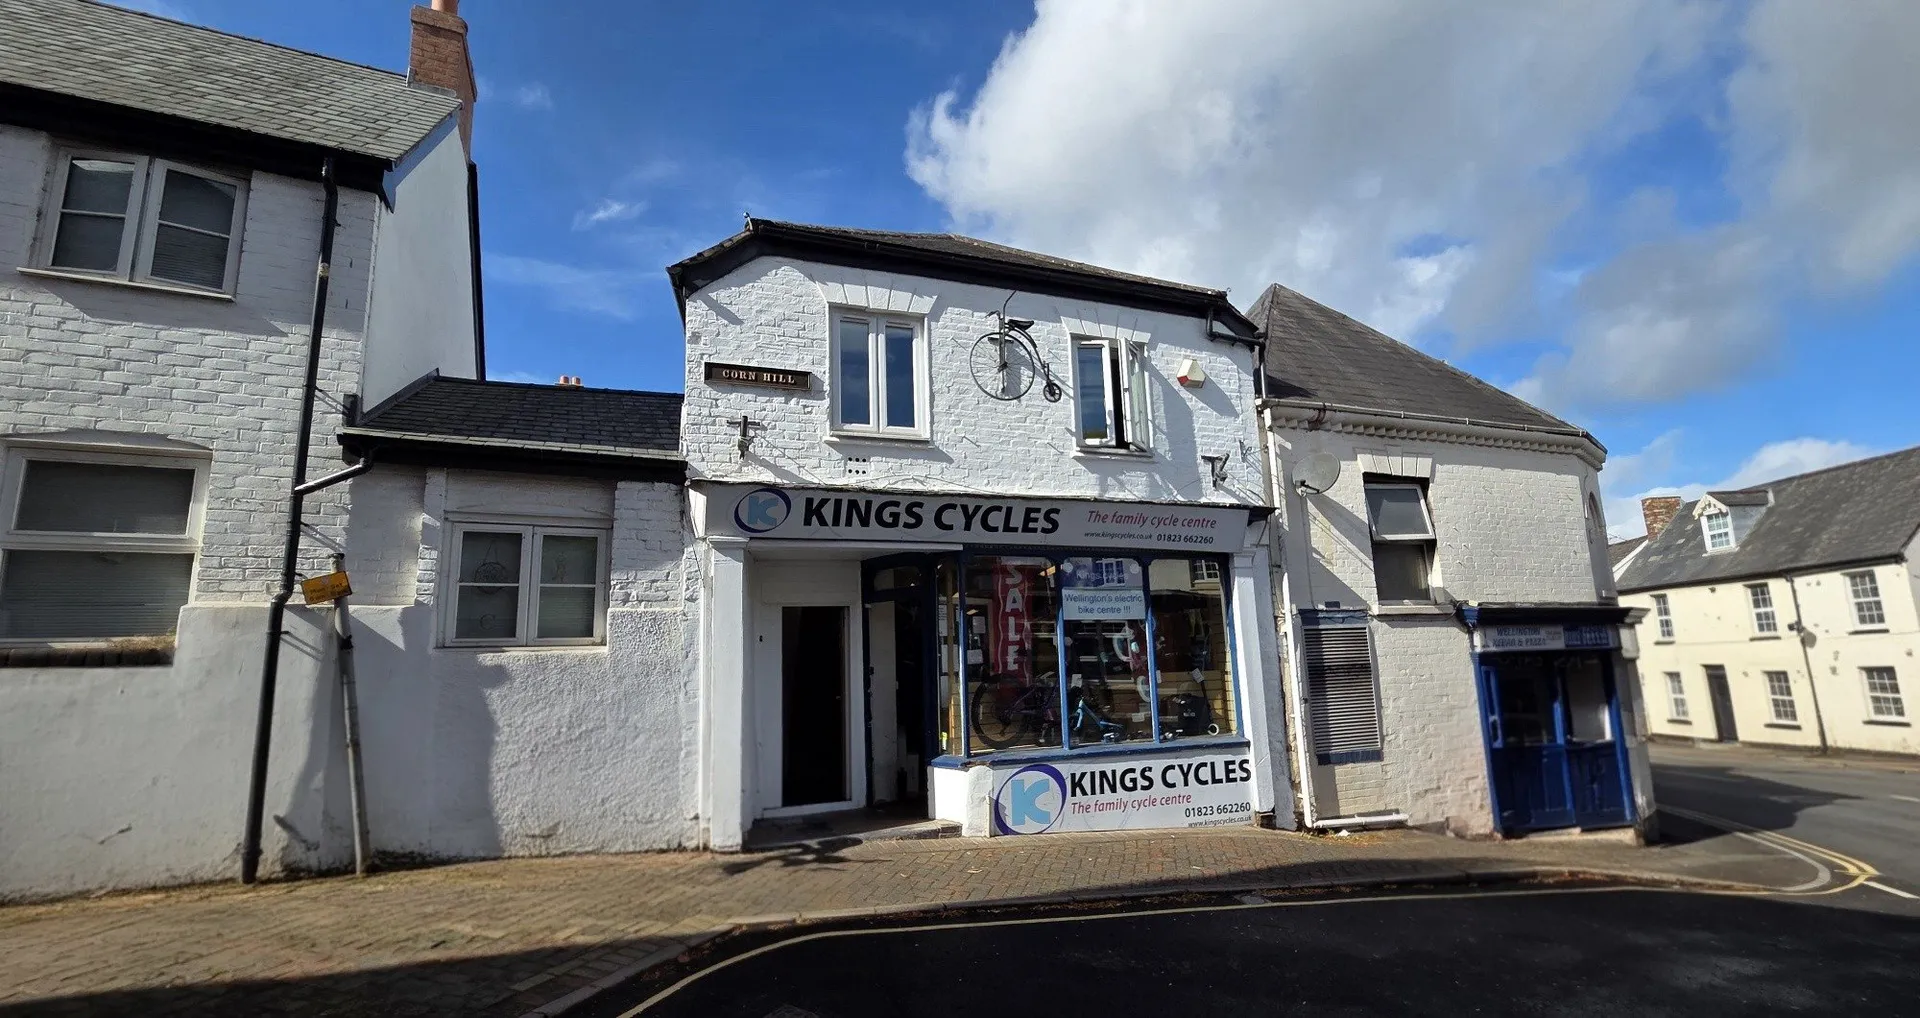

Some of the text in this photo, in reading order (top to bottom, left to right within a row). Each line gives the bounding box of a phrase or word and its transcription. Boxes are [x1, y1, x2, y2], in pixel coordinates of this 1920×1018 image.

[722, 369, 795, 384] CORN HILL
[803, 497, 1061, 534] KINGS CYCLES
[1087, 510, 1217, 529] The family cycle centre
[1084, 530, 1214, 545] www.kingscycles.co.uk 01823 662260
[1064, 593, 1142, 605] Wellington's electric
[1078, 605, 1095, 614] bike
[1096, 606, 1122, 614] centre
[1005, 565, 1024, 671] SALE
[1070, 758, 1252, 798] KINGS CYCLES
[1071, 793, 1192, 815] The family cycle centre
[1184, 802, 1251, 818] 01823 662260
[1188, 814, 1252, 828] www.kingscycles.co.uk
